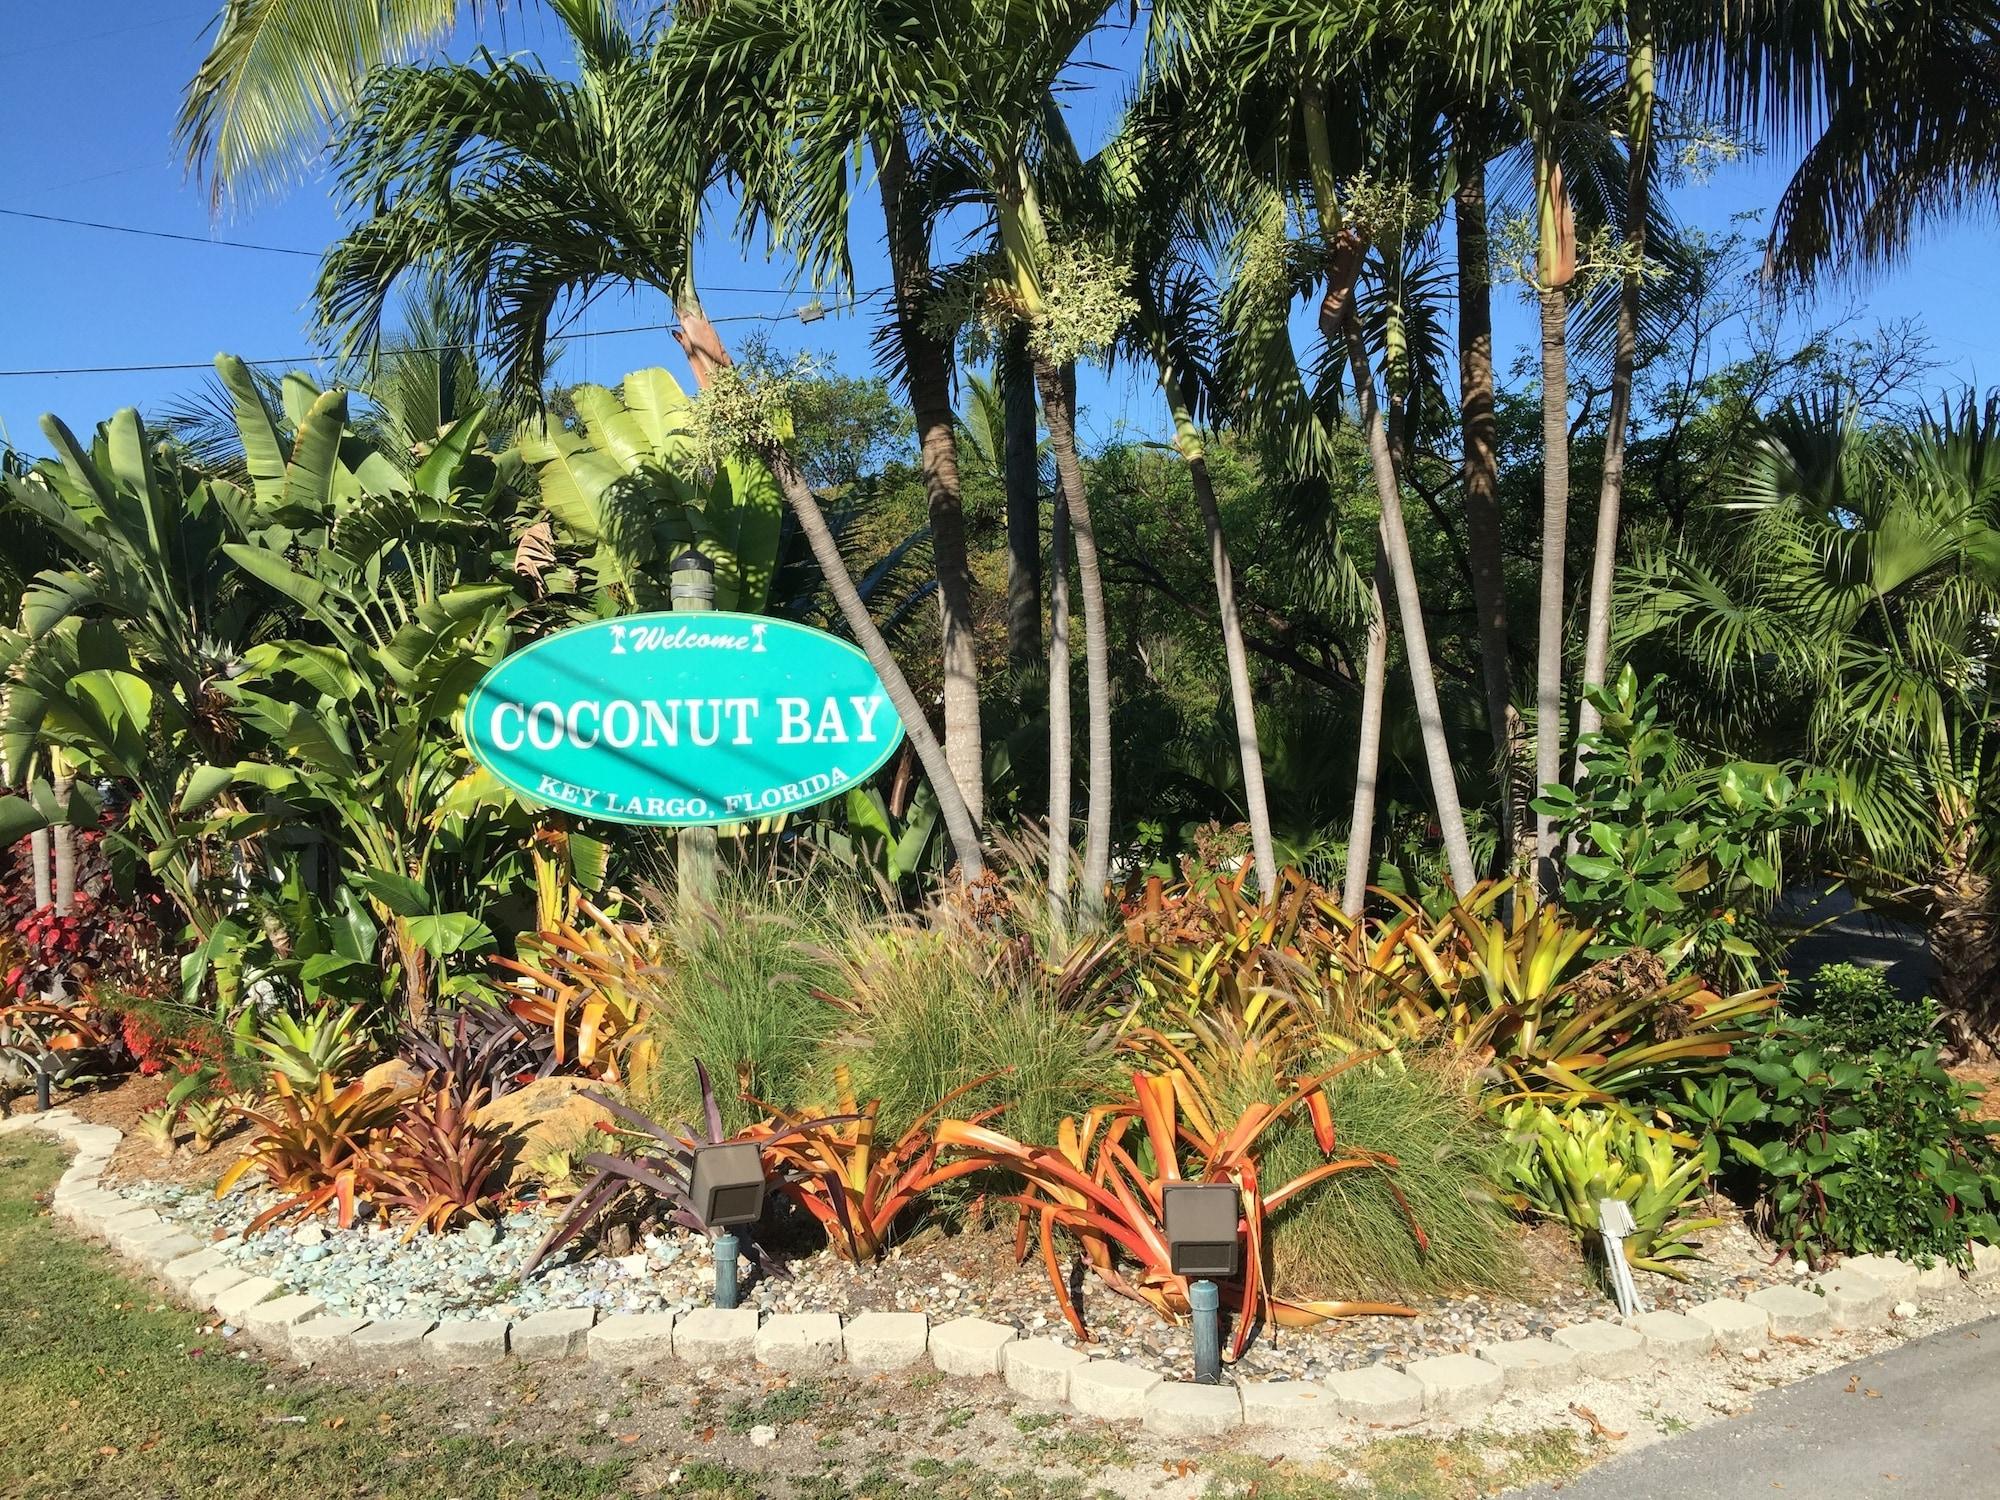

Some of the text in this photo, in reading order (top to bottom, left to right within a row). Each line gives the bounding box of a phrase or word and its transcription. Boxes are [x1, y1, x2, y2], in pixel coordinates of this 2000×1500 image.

[629, 625, 751, 652] Welcome
[490, 696, 886, 752] COCONUT BAY
[537, 766, 850, 819] KEY LARGO, FLORIDA
